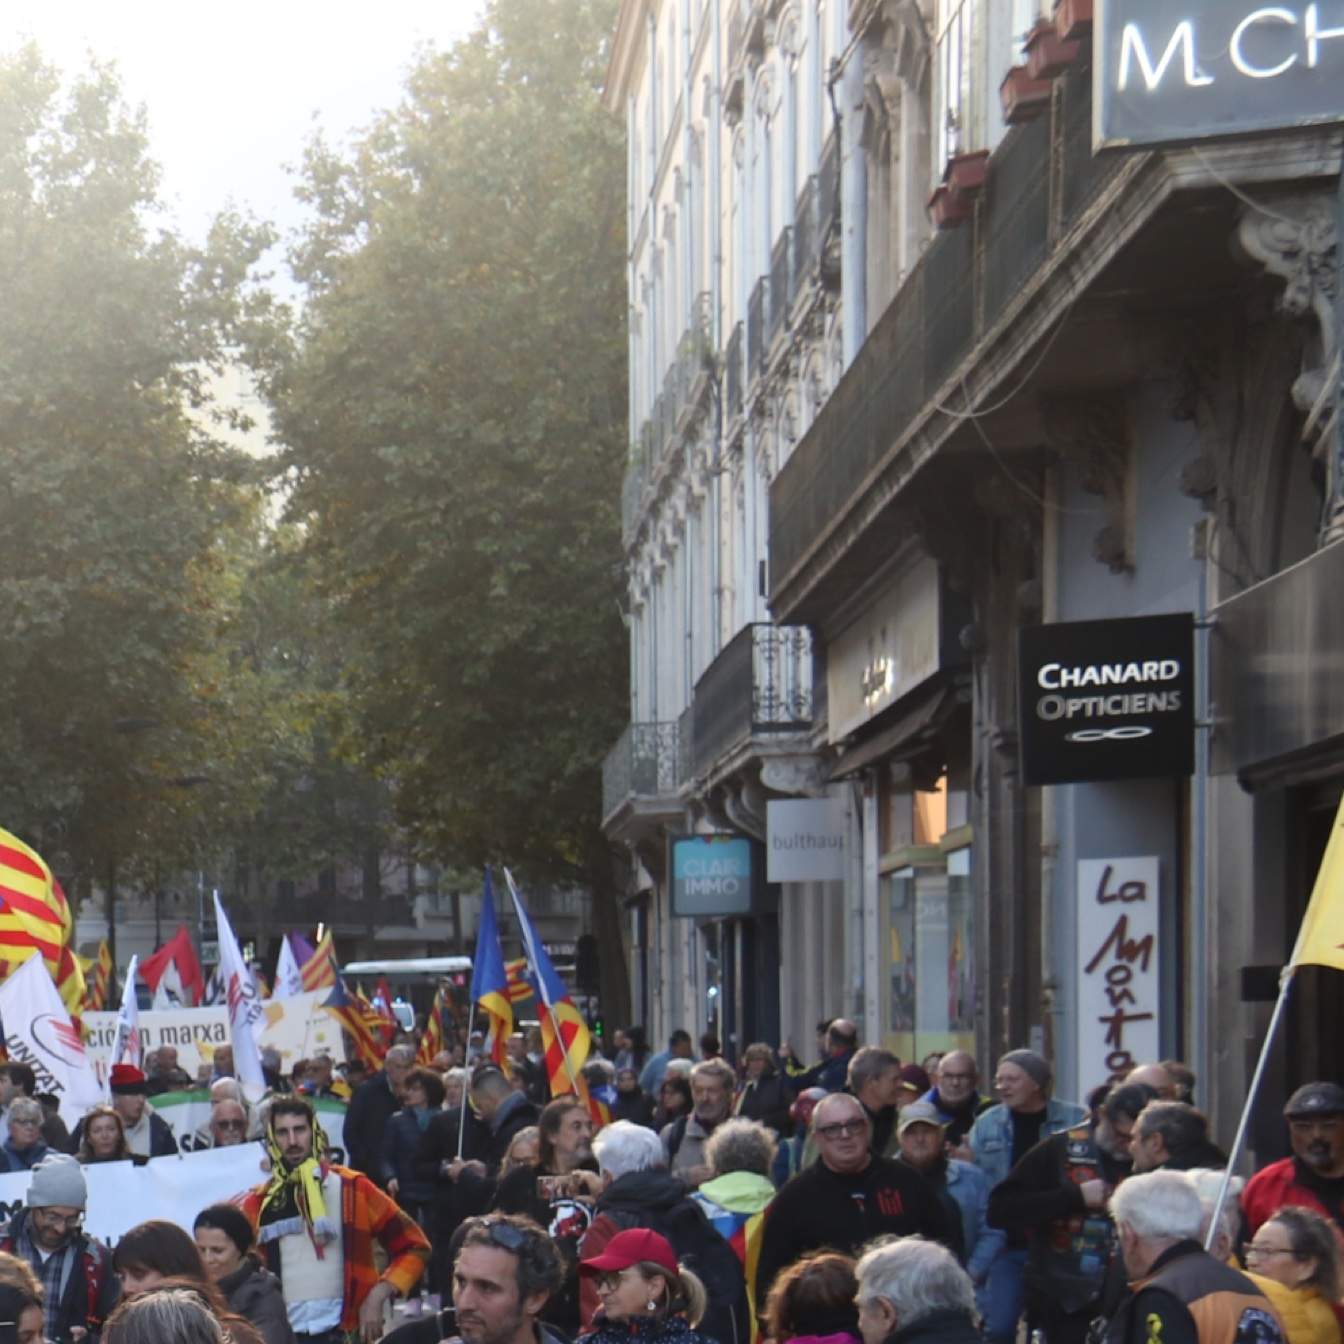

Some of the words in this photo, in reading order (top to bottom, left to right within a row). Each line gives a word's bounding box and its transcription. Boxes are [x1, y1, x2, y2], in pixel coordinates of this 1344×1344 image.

[1037, 659, 1181, 689] CHANARD
[1036, 690, 1182, 721] OPTICIENS
[685, 876, 740, 896] IMMO
[1096, 863, 1147, 905] La
[159, 1021, 226, 1046] marxa
